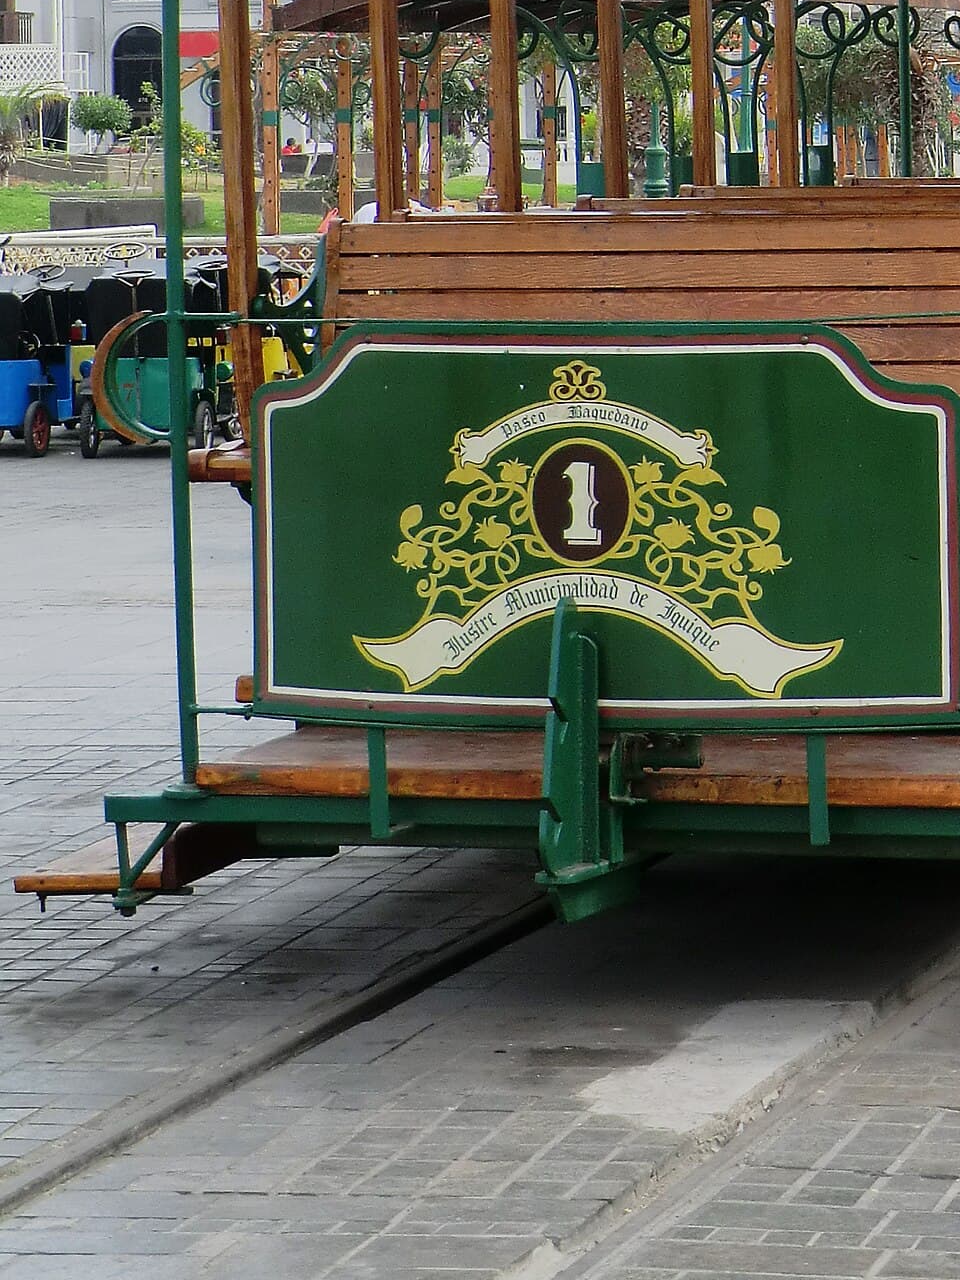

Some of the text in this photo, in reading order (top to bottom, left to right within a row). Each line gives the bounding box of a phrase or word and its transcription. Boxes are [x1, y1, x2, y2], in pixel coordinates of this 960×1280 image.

[501, 405, 649, 438] Paseo Baquedano
[562, 461, 602, 545] 1
[442, 575, 721, 661] Ilustre Municipalidad de Iquique
